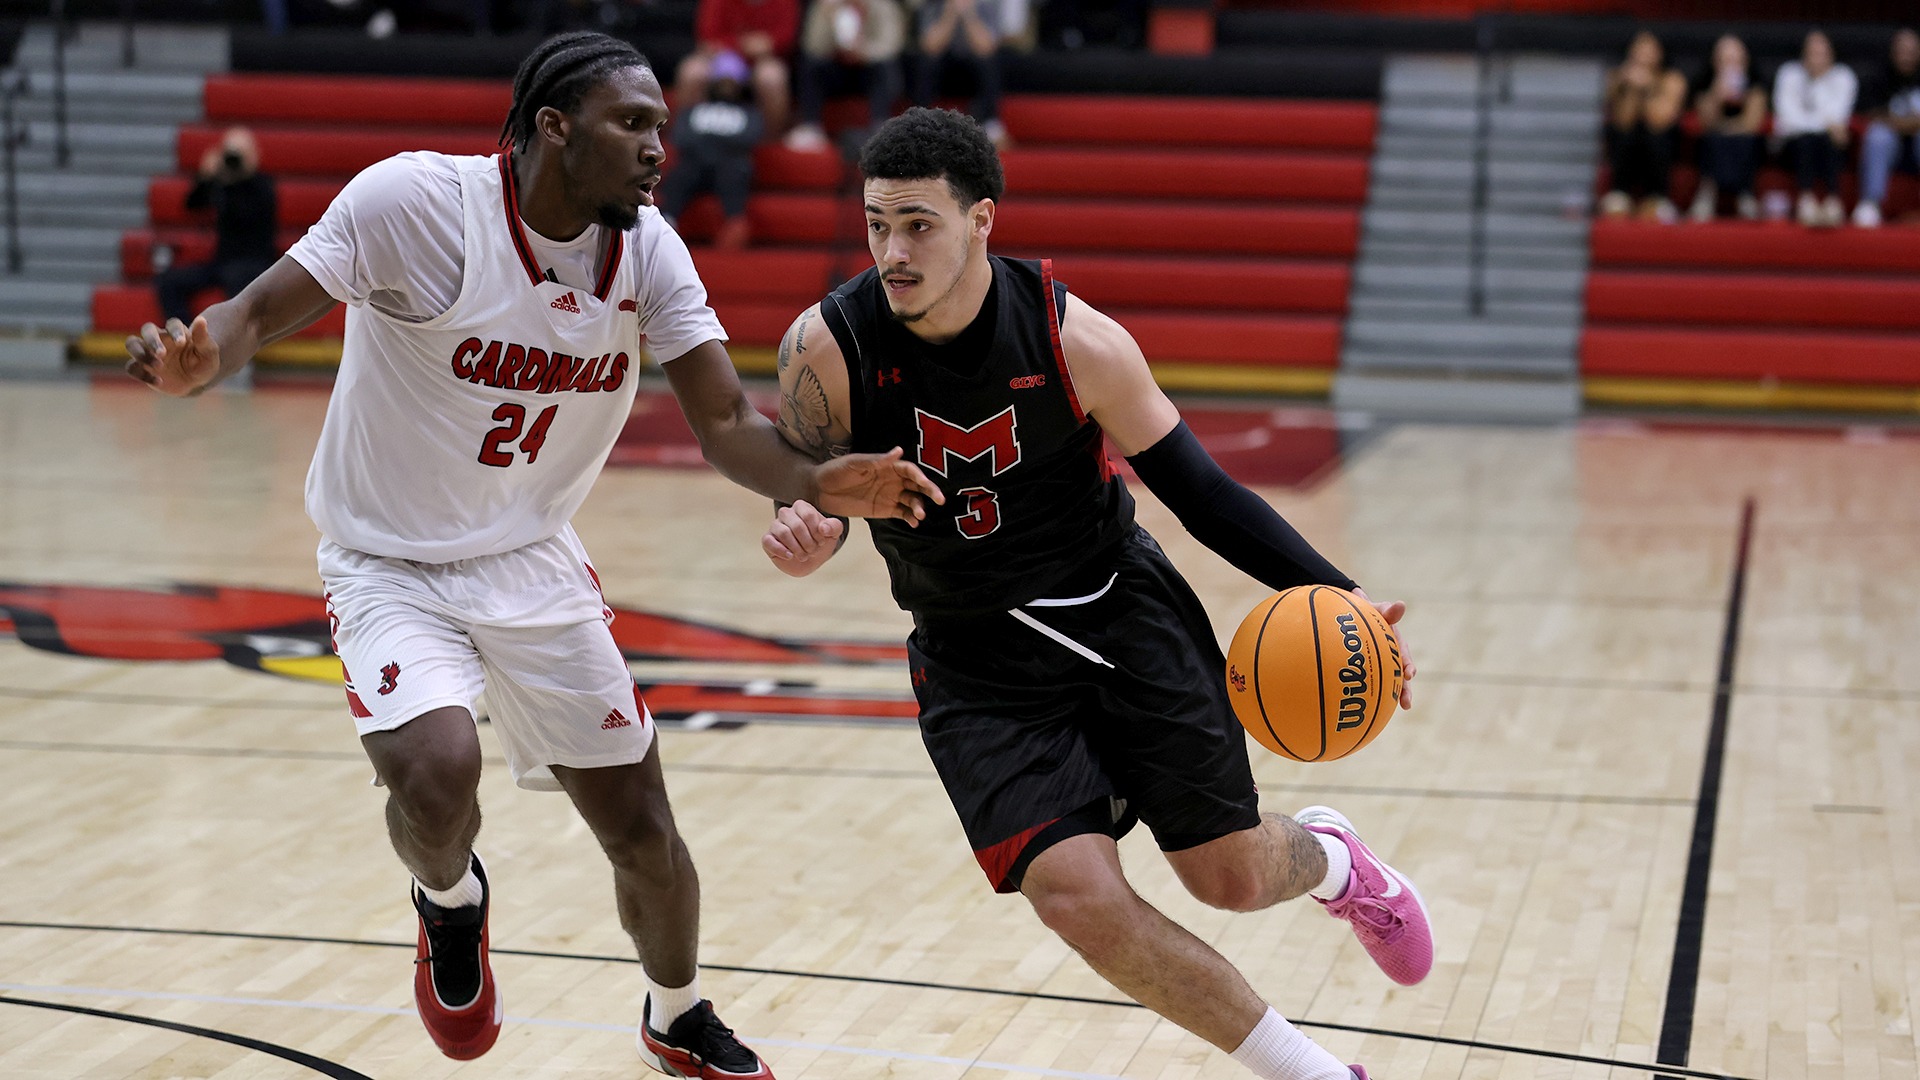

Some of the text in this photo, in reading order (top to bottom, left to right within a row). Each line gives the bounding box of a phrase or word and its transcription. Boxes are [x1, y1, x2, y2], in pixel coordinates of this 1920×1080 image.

[550, 301, 581, 314] adidas
[451, 337, 629, 394] CARDINALS
[1010, 374, 1046, 389] GLVC
[478, 402, 559, 467] 24
[914, 404, 1022, 479] M
[955, 486, 1001, 539] 3
[1335, 612, 1368, 732] Wilson
[601, 719, 631, 730] adidas
